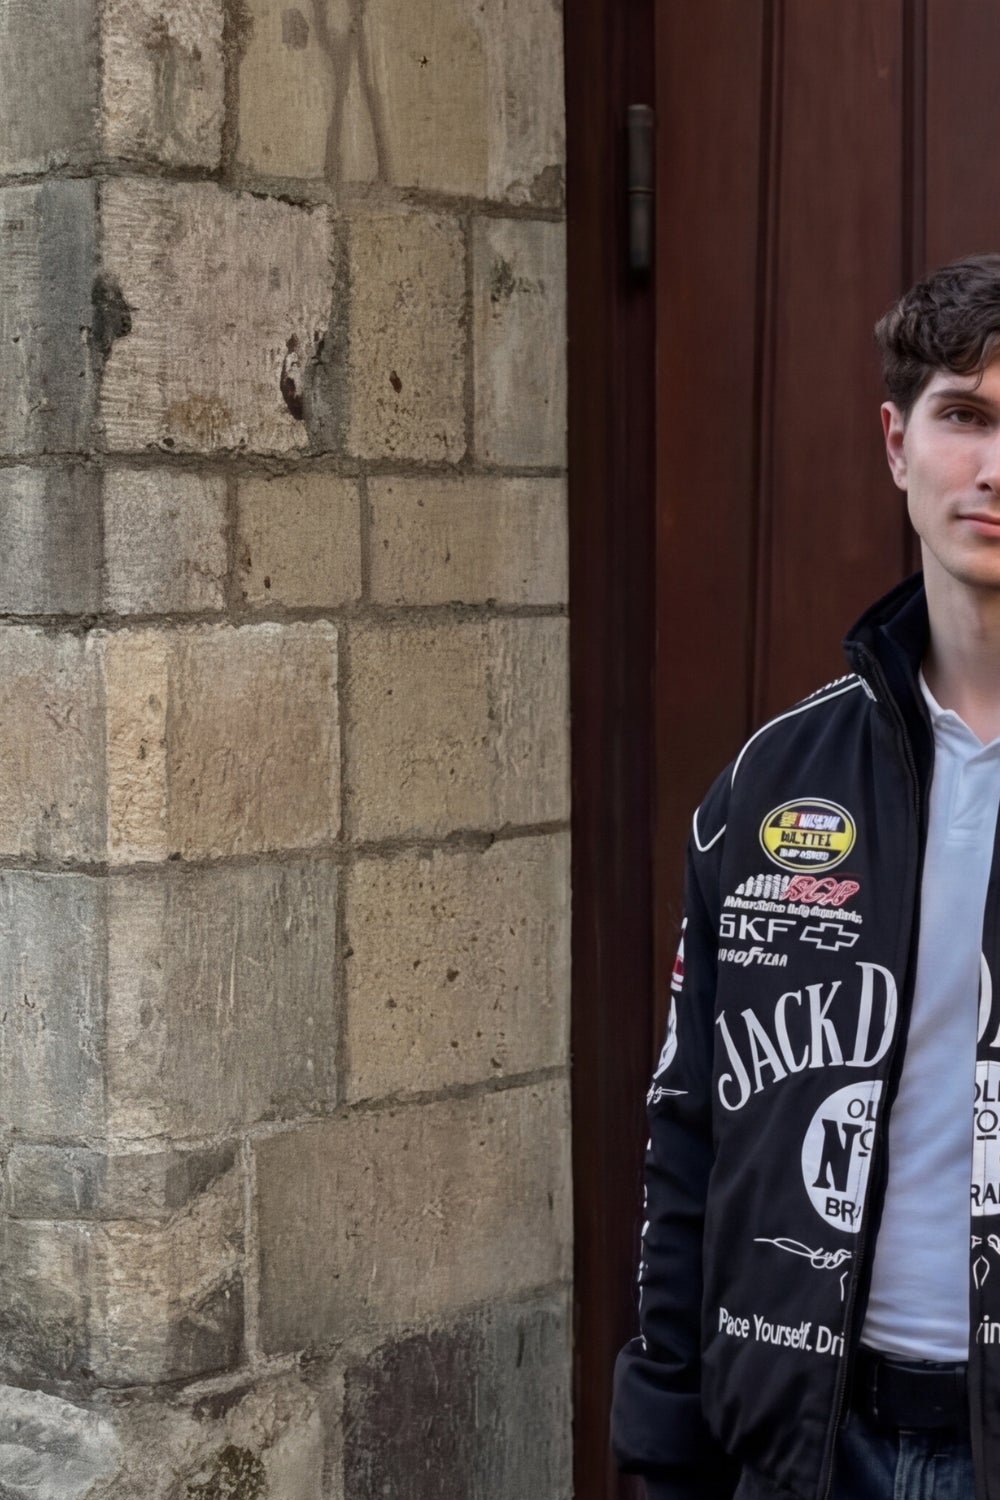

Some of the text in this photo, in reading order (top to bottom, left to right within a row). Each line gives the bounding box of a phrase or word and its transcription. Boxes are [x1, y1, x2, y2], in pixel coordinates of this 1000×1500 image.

[719, 913, 797, 942] SKF
[715, 980, 844, 1111] JACK
[825, 1197, 861, 1226] BR
[718, 1306, 750, 1338] Pace
[816, 1325, 845, 1357] Dri
